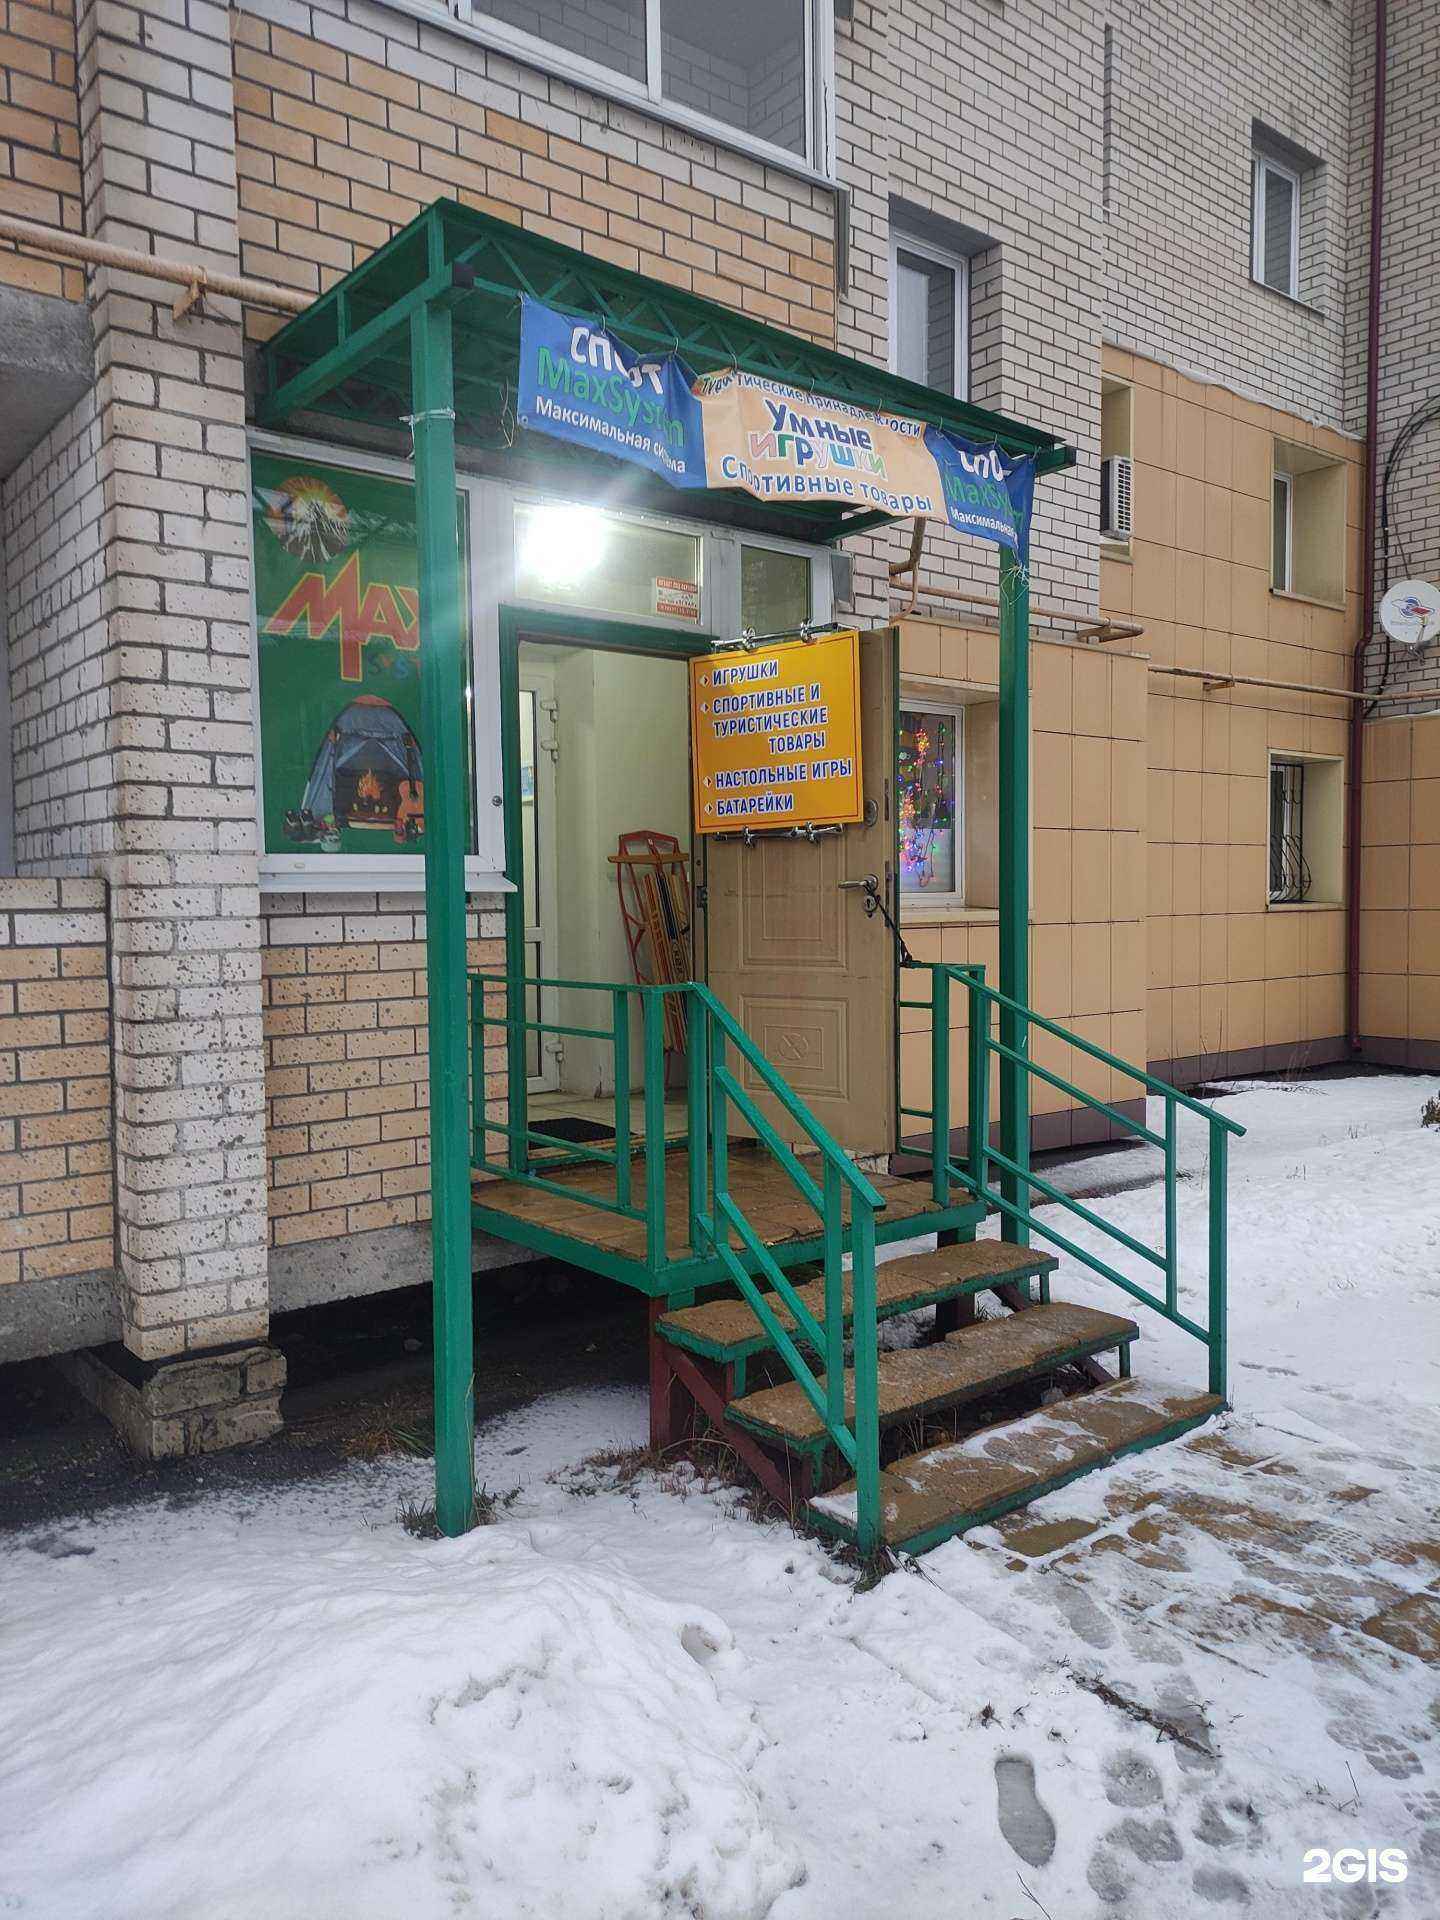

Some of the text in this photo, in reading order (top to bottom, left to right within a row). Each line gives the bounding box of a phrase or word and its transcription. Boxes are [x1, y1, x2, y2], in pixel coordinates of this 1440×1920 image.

[702, 371, 922, 436] Туритические принадлежости
[536, 396, 651, 451] Максимальная
[764, 399, 872, 451] Умные
[859, 482, 933, 514] товары
[712, 661, 778, 686] ИГРУШКИ
[713, 684, 820, 714] СПОРТИВНЫЕ И
[713, 707, 828, 737] ТУРИСТИЧЕСКИЕ
[769, 732, 825, 754] ТОВАРЫ
[715, 759, 852, 788] НАСТОЛЬНЫЕ ИГРЫ
[717, 793, 794, 816] БАТАРЕЙКИ
